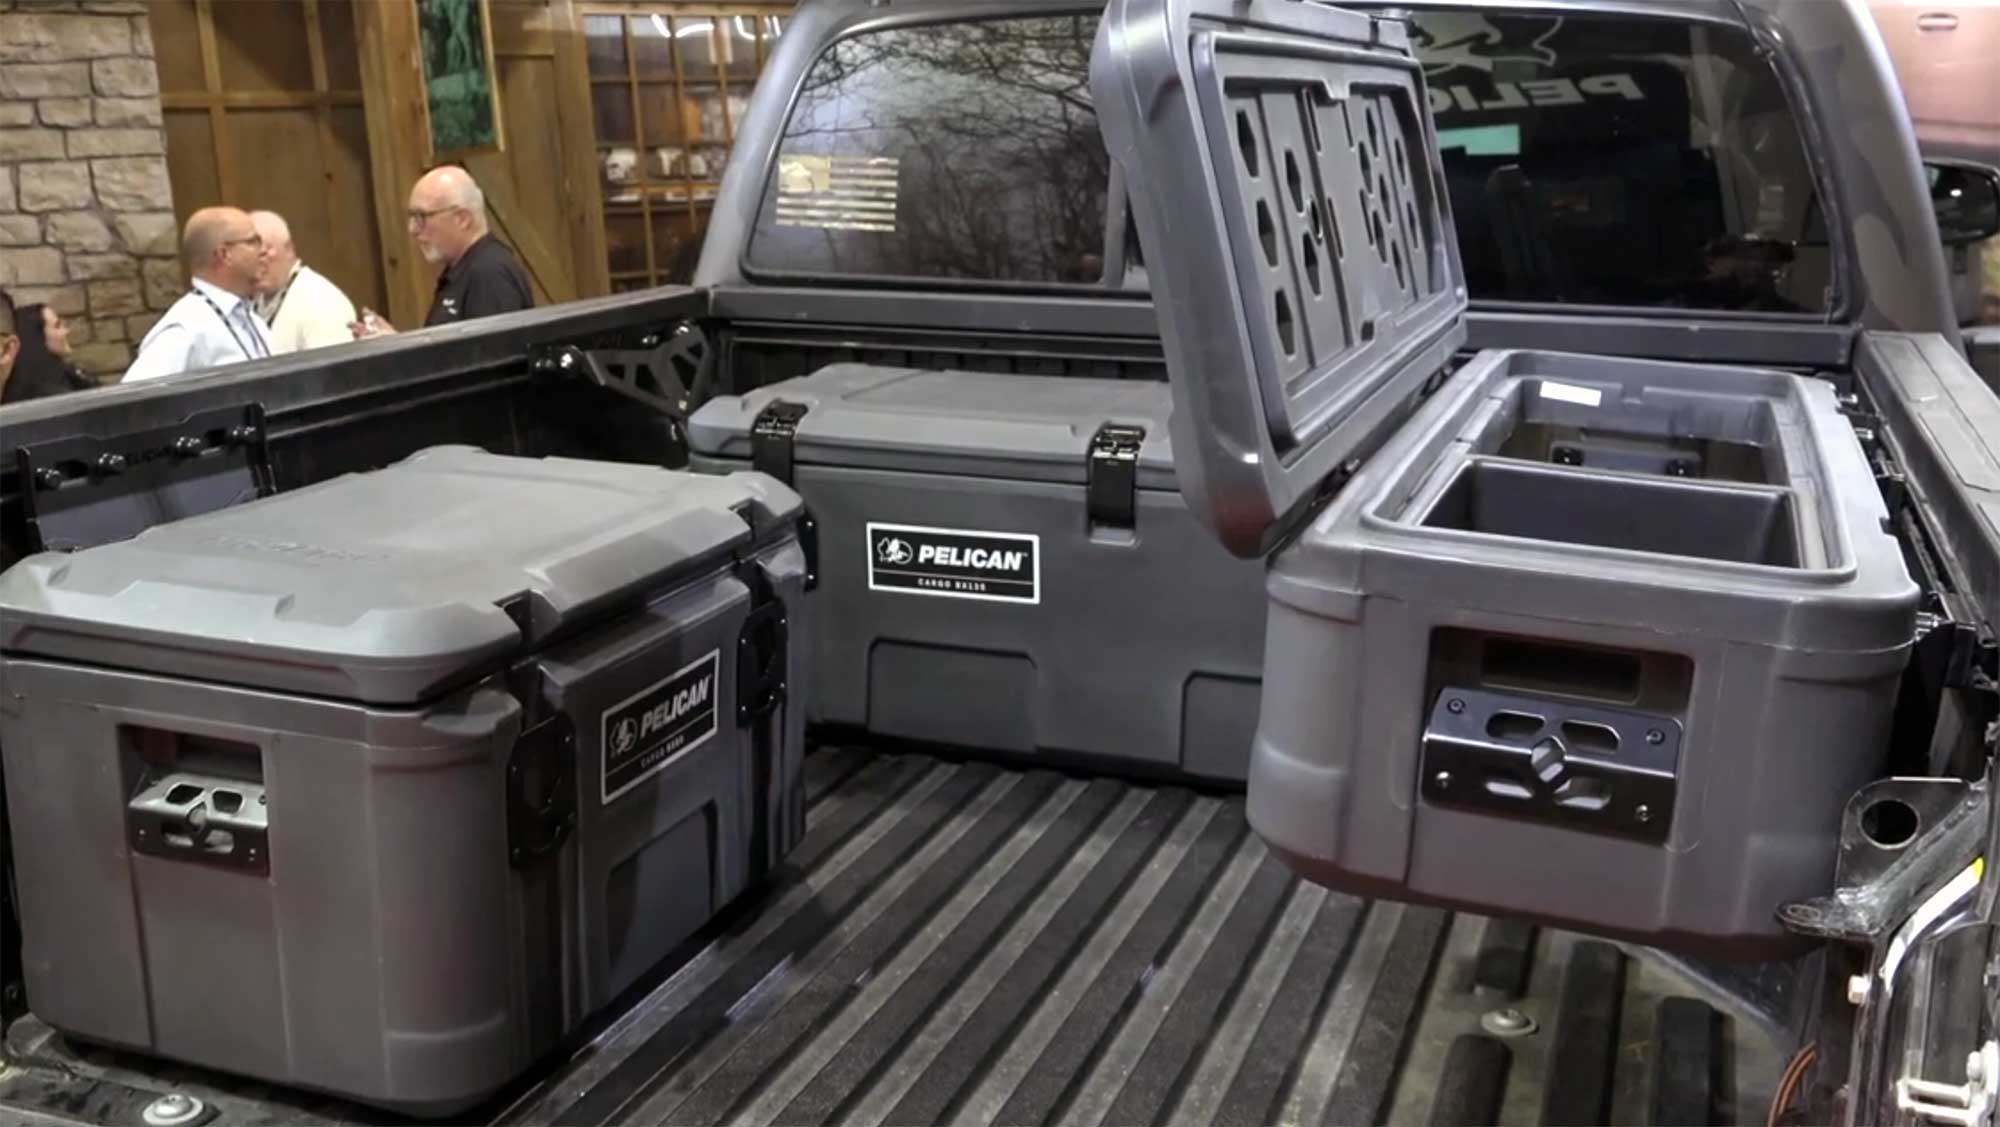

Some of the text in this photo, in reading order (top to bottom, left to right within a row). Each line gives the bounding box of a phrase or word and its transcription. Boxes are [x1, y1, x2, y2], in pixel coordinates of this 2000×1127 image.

[918, 544, 1022, 571] PELICAN
[917, 577, 951, 589] CARGO
[640, 676, 710, 739] PELICAN
